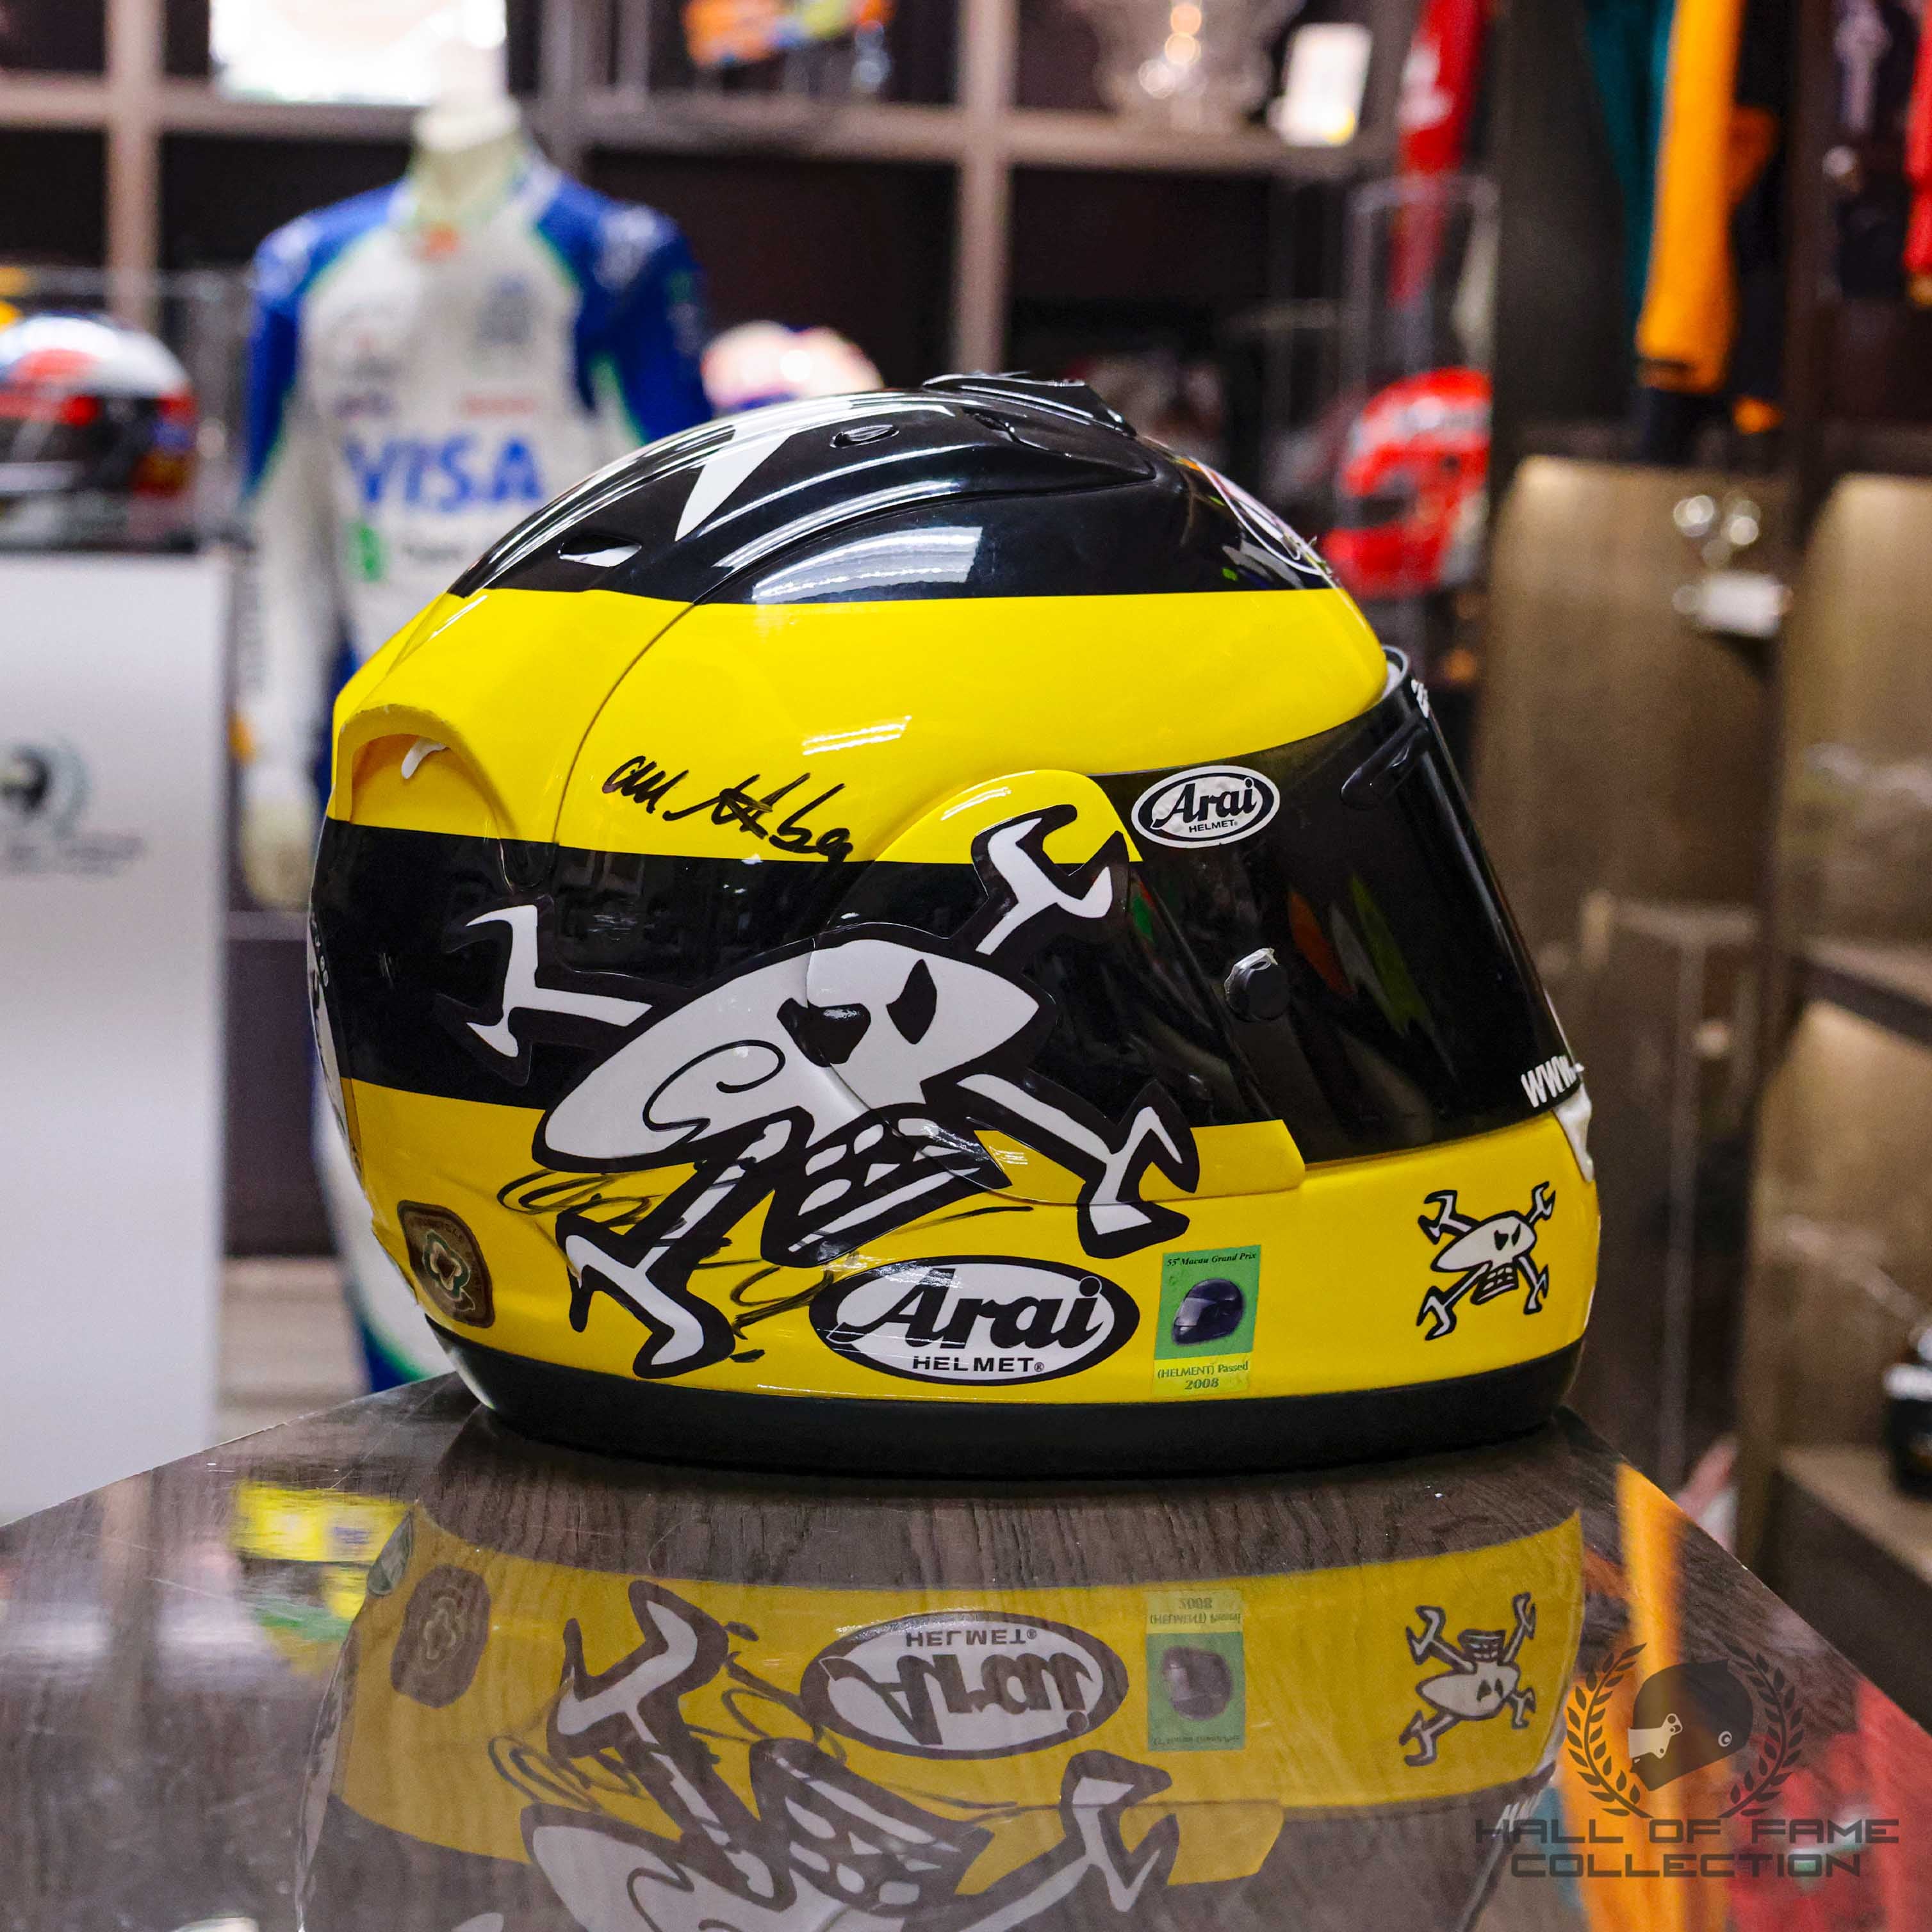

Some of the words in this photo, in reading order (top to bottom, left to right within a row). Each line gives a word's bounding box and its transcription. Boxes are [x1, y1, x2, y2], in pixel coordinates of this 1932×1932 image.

[342, 432, 542, 510] VISA
[1151, 777, 1257, 829] Arai
[1167, 1257, 1180, 1266] 55
[1211, 1254, 1238, 1262] Grand
[826, 1267, 1103, 1349] Arai
[1158, 1365, 1215, 1379] (HELMENT)
[1218, 1361, 1248, 1373] Passed
[1184, 1378, 1219, 1389] 2008
